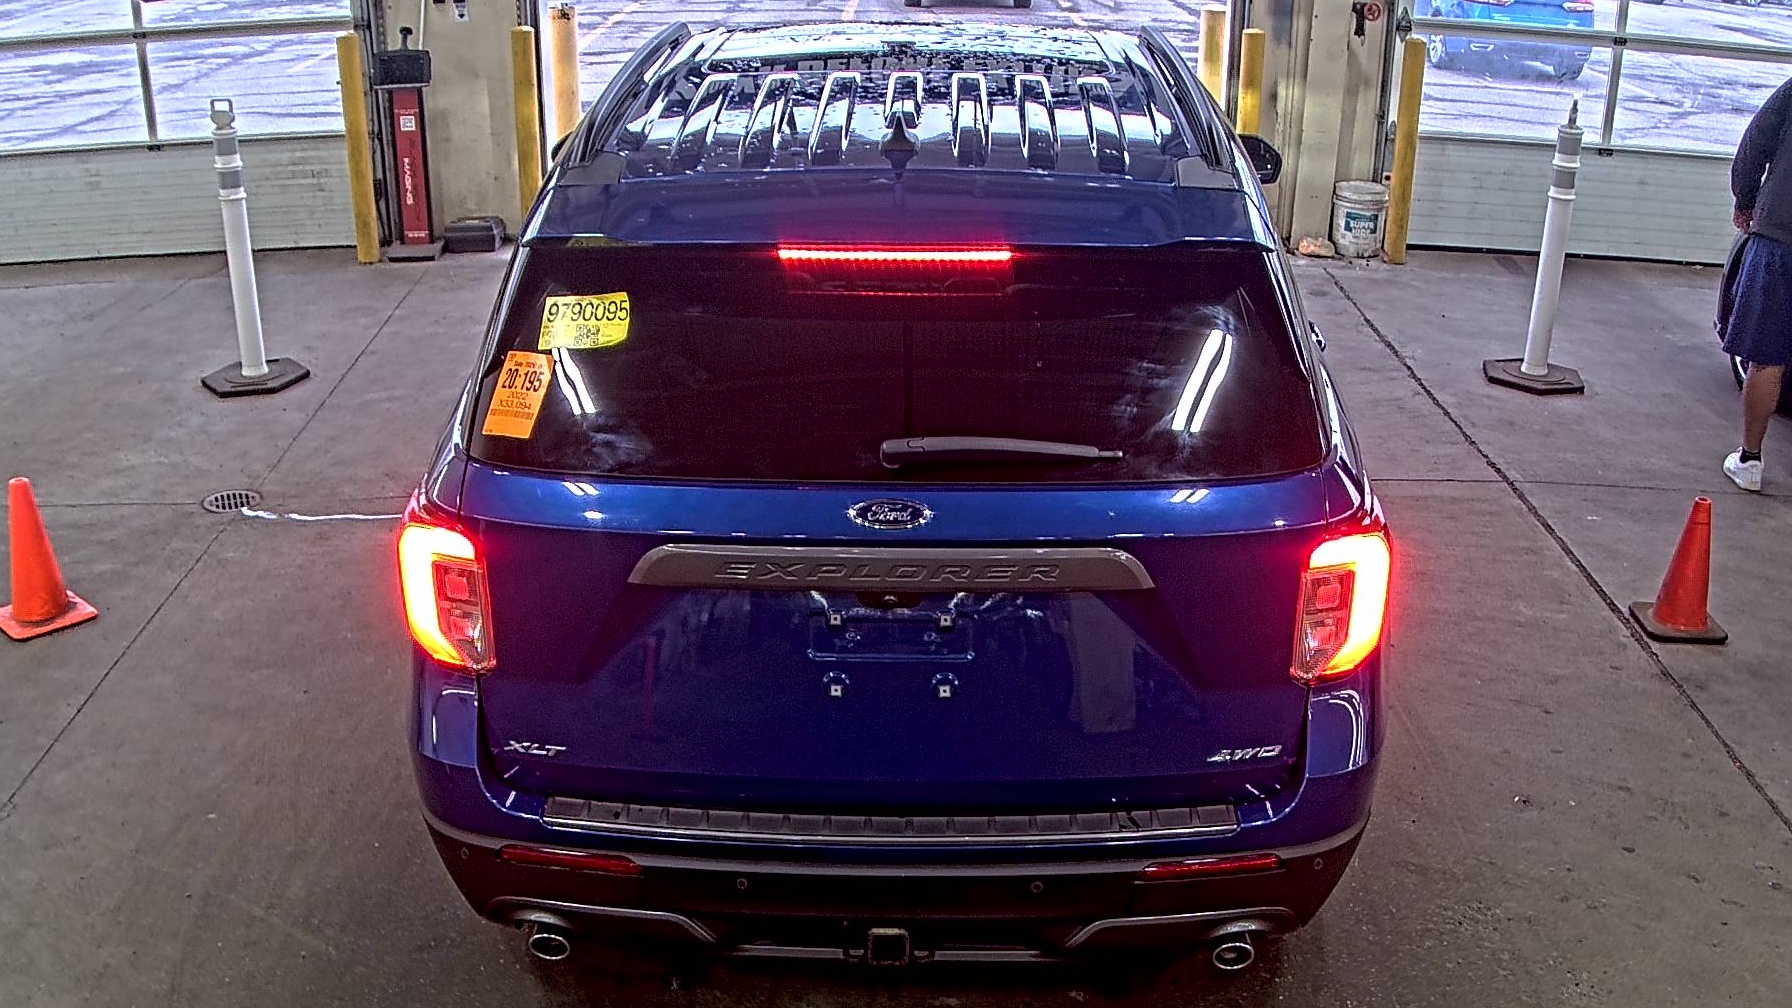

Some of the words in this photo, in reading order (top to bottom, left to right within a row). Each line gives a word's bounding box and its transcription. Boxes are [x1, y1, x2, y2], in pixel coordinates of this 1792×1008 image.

[547, 300, 629, 323] 9790095
[501, 368, 545, 393] 20:195
[507, 390, 529, 400] 2022
[867, 503, 913, 522] Ford
[714, 561, 1063, 583] EXPLORER
[503, 740, 567, 757] XLT
[1206, 744, 1283, 762] 4WD
